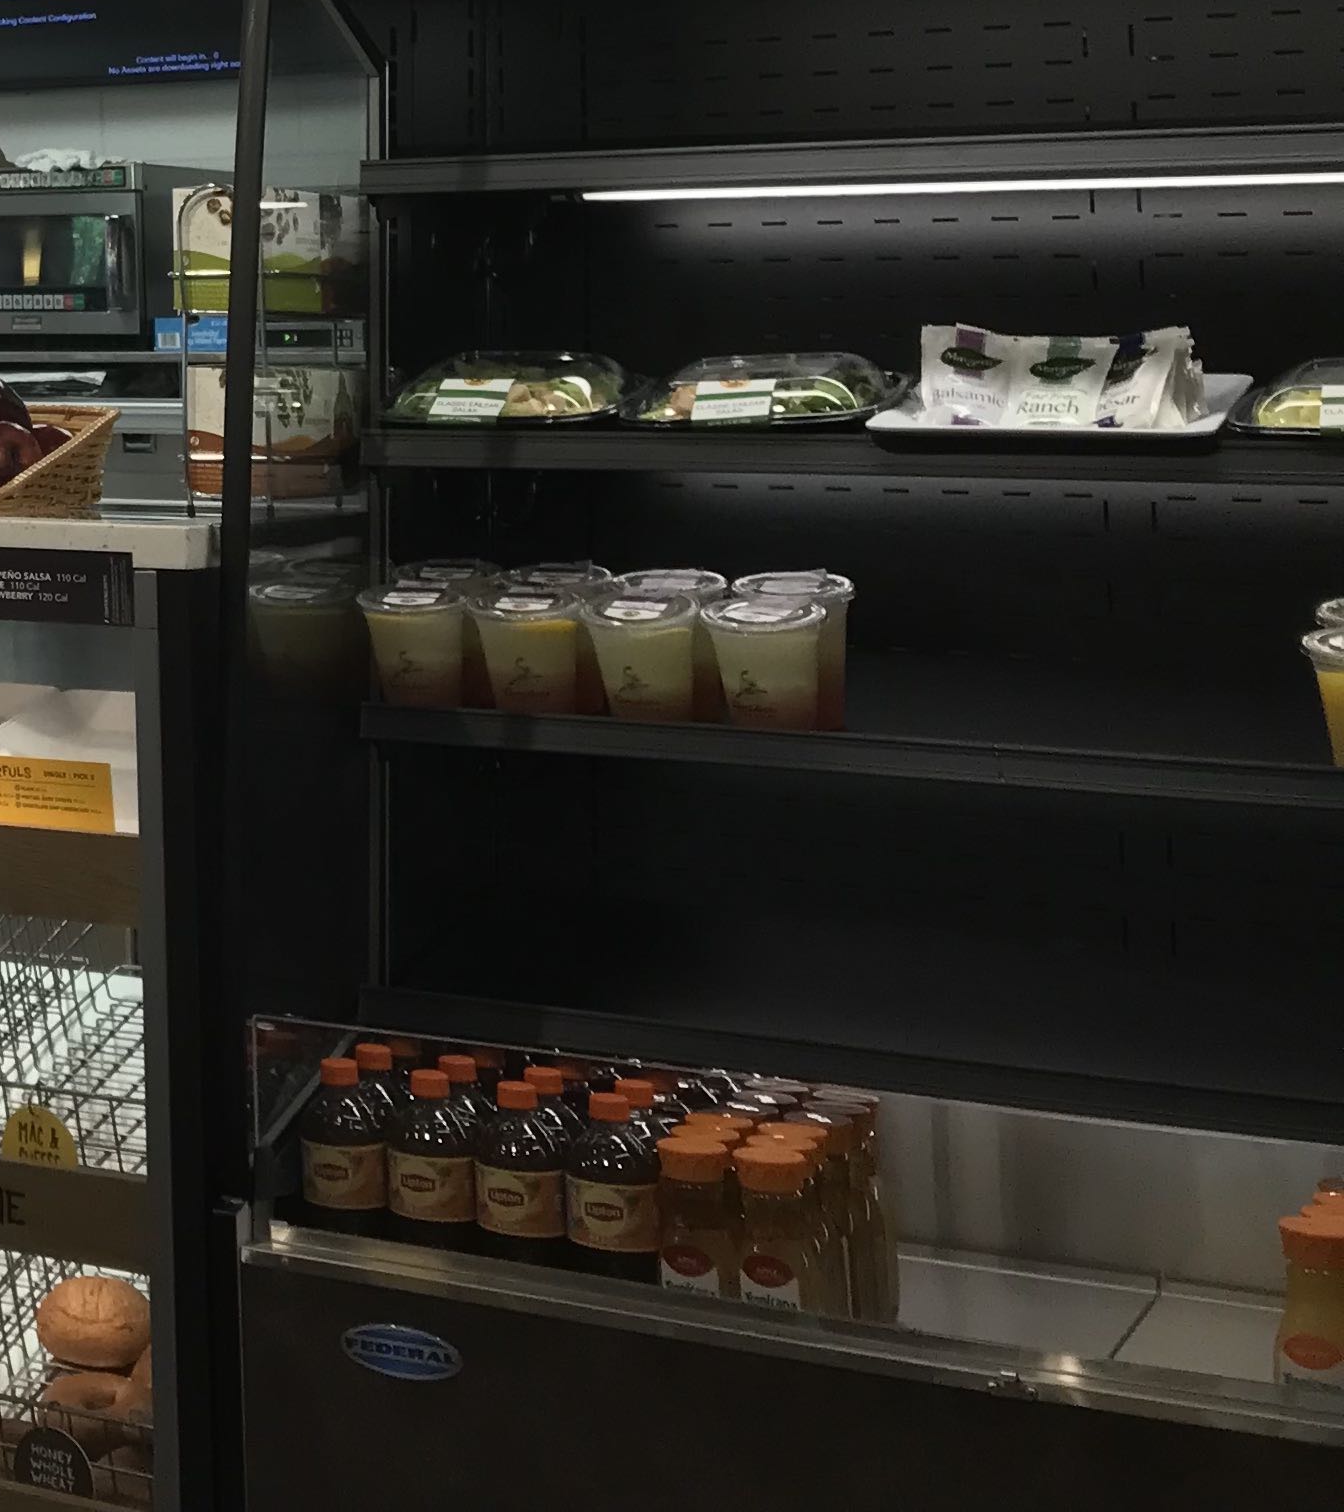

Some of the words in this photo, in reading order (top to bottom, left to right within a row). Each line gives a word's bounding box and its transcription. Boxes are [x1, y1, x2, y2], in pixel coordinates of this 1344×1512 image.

[48, 12, 96, 23] Configuration
[1016, 399, 1079, 416] Ranch
[23, 572, 52, 582] SALSA
[72, 573, 87, 583] Cal
[26, 582, 40, 591] Cal
[54, 593, 68, 603] Cal
[18, 1121, 43, 1146] MAC
[49, 1127, 59, 1149] &
[402, 1174, 433, 1189] Lipton
[587, 1203, 622, 1218] Lipton
[344, 1336, 458, 1368] FEDERAL
[30, 1443, 72, 1464] HONEY
[30, 1457, 75, 1480] WHOLE
[30, 1470, 74, 1494] WHEAT
